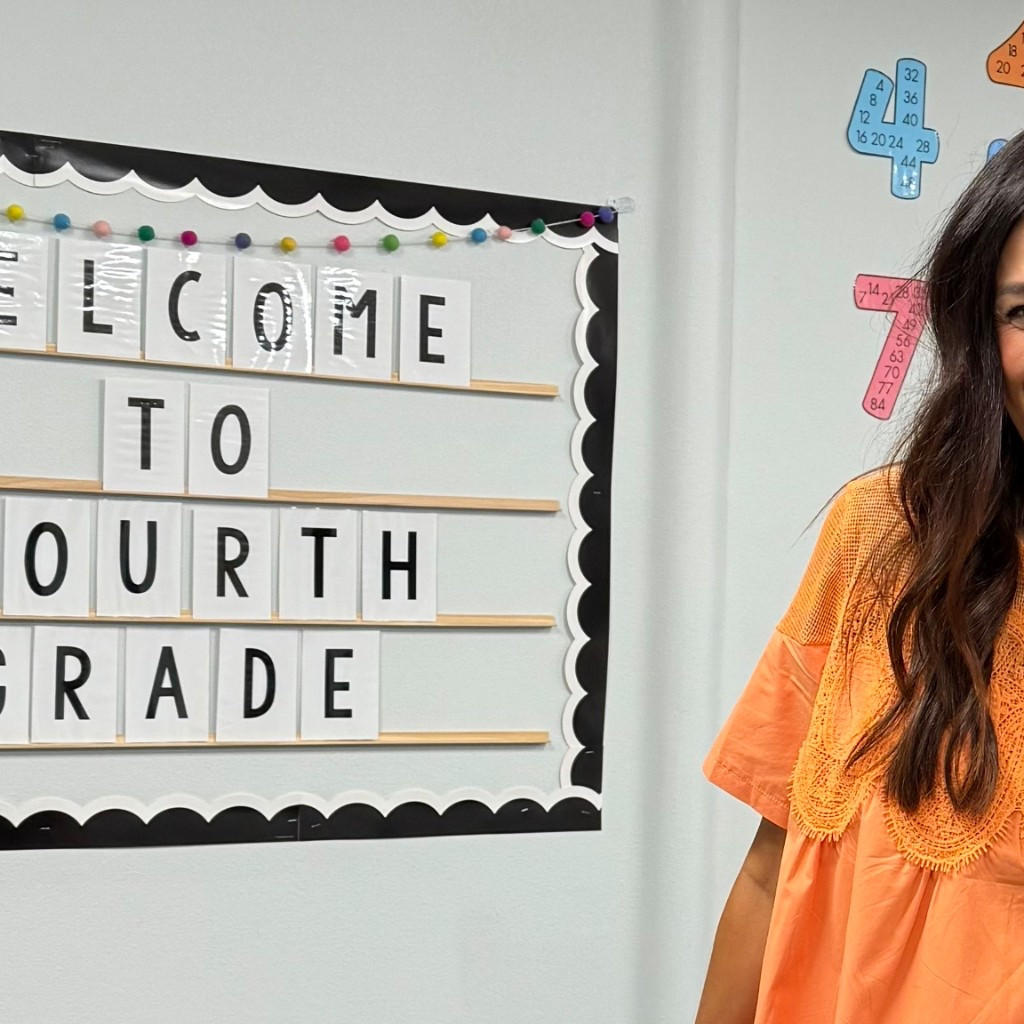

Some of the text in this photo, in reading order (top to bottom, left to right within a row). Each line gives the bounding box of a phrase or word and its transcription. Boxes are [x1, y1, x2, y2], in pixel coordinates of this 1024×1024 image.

[1008, 44, 1017, 57] 18
[996, 60, 1011, 74] 20
[904, 67, 919, 82] 32
[876, 79, 884, 91] 4
[870, 93, 877, 106] 8
[903, 91, 918, 105] 36
[859, 109, 870, 124] 12
[902, 113, 918, 127] 40
[856, 129, 868, 144] 16
[871, 132, 887, 147] 20
[888, 135, 904, 149] 24
[915, 139, 930, 153] 28
[900, 154, 916, 168] 44
[868, 282, 879, 295] 14
[859, 291, 867, 304] 7
[902, 319, 916, 331] 49
[896, 333, 911, 347] 56
[889, 349, 904, 363] 63
[884, 365, 900, 379] 70
[878, 381, 894, 395] 77
[869, 397, 886, 411] 84
[127, 396, 252, 476] TO
